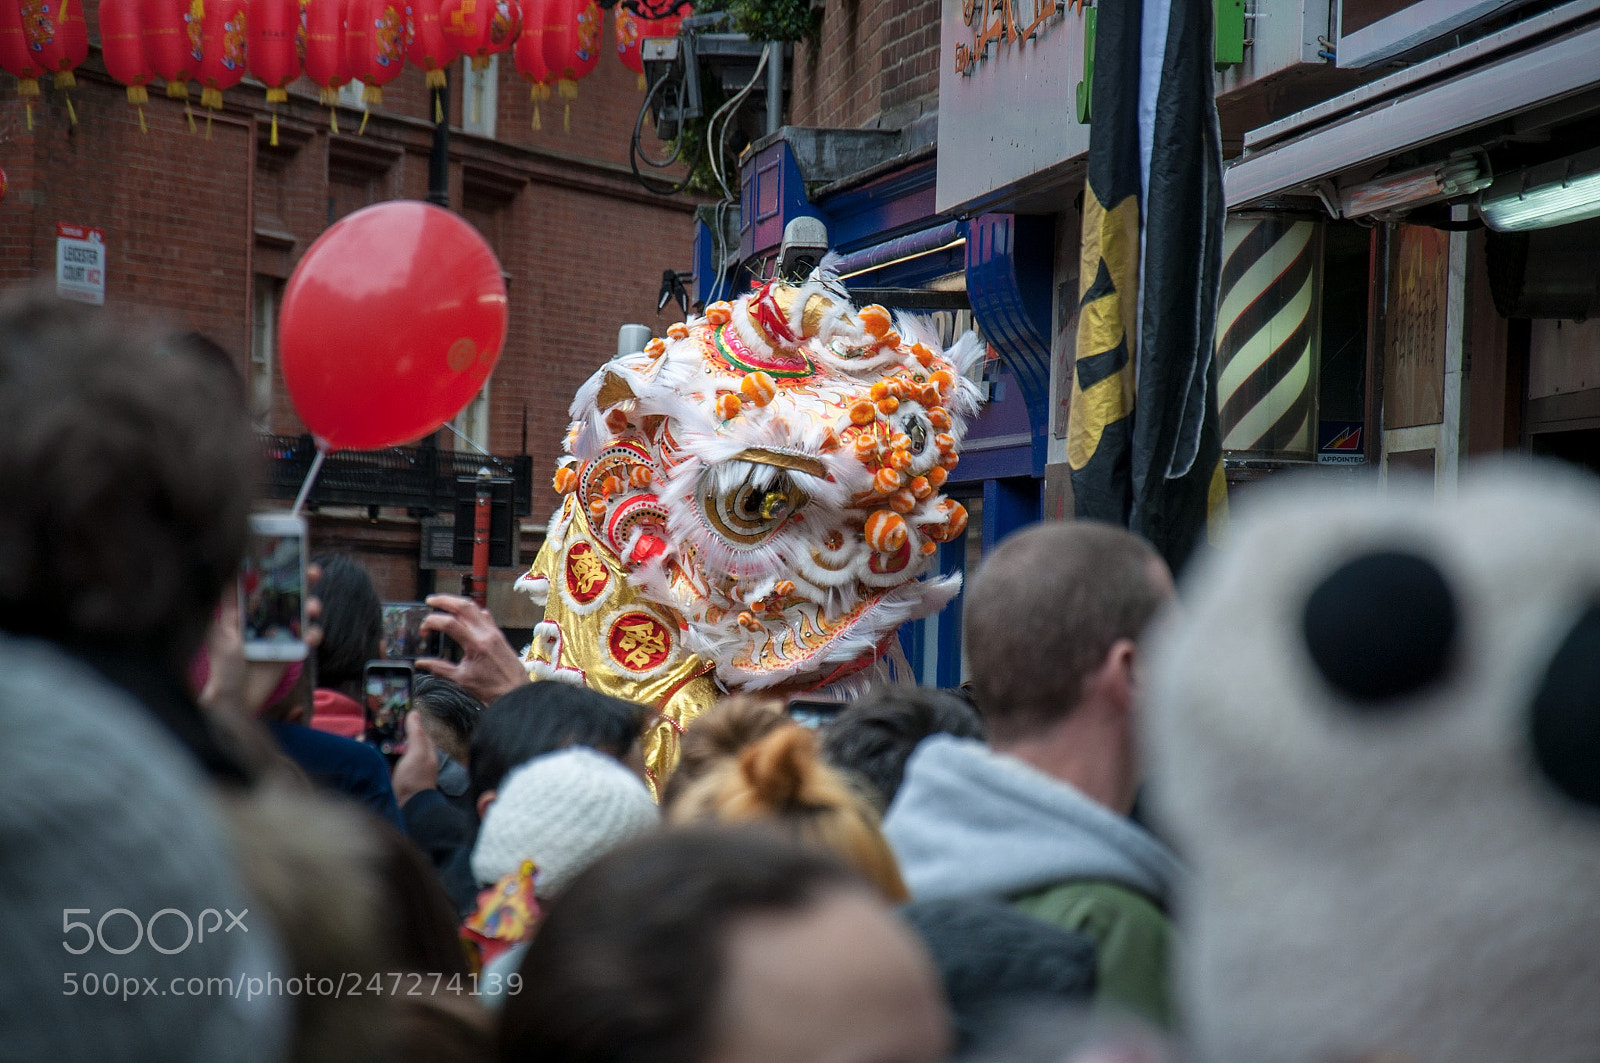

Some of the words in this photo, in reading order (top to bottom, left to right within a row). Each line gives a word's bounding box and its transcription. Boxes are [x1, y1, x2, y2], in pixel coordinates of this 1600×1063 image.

[64, 246, 98, 265] LEICESTER
[63, 265, 85, 282] COURT
[617, 621, 666, 668] 館
